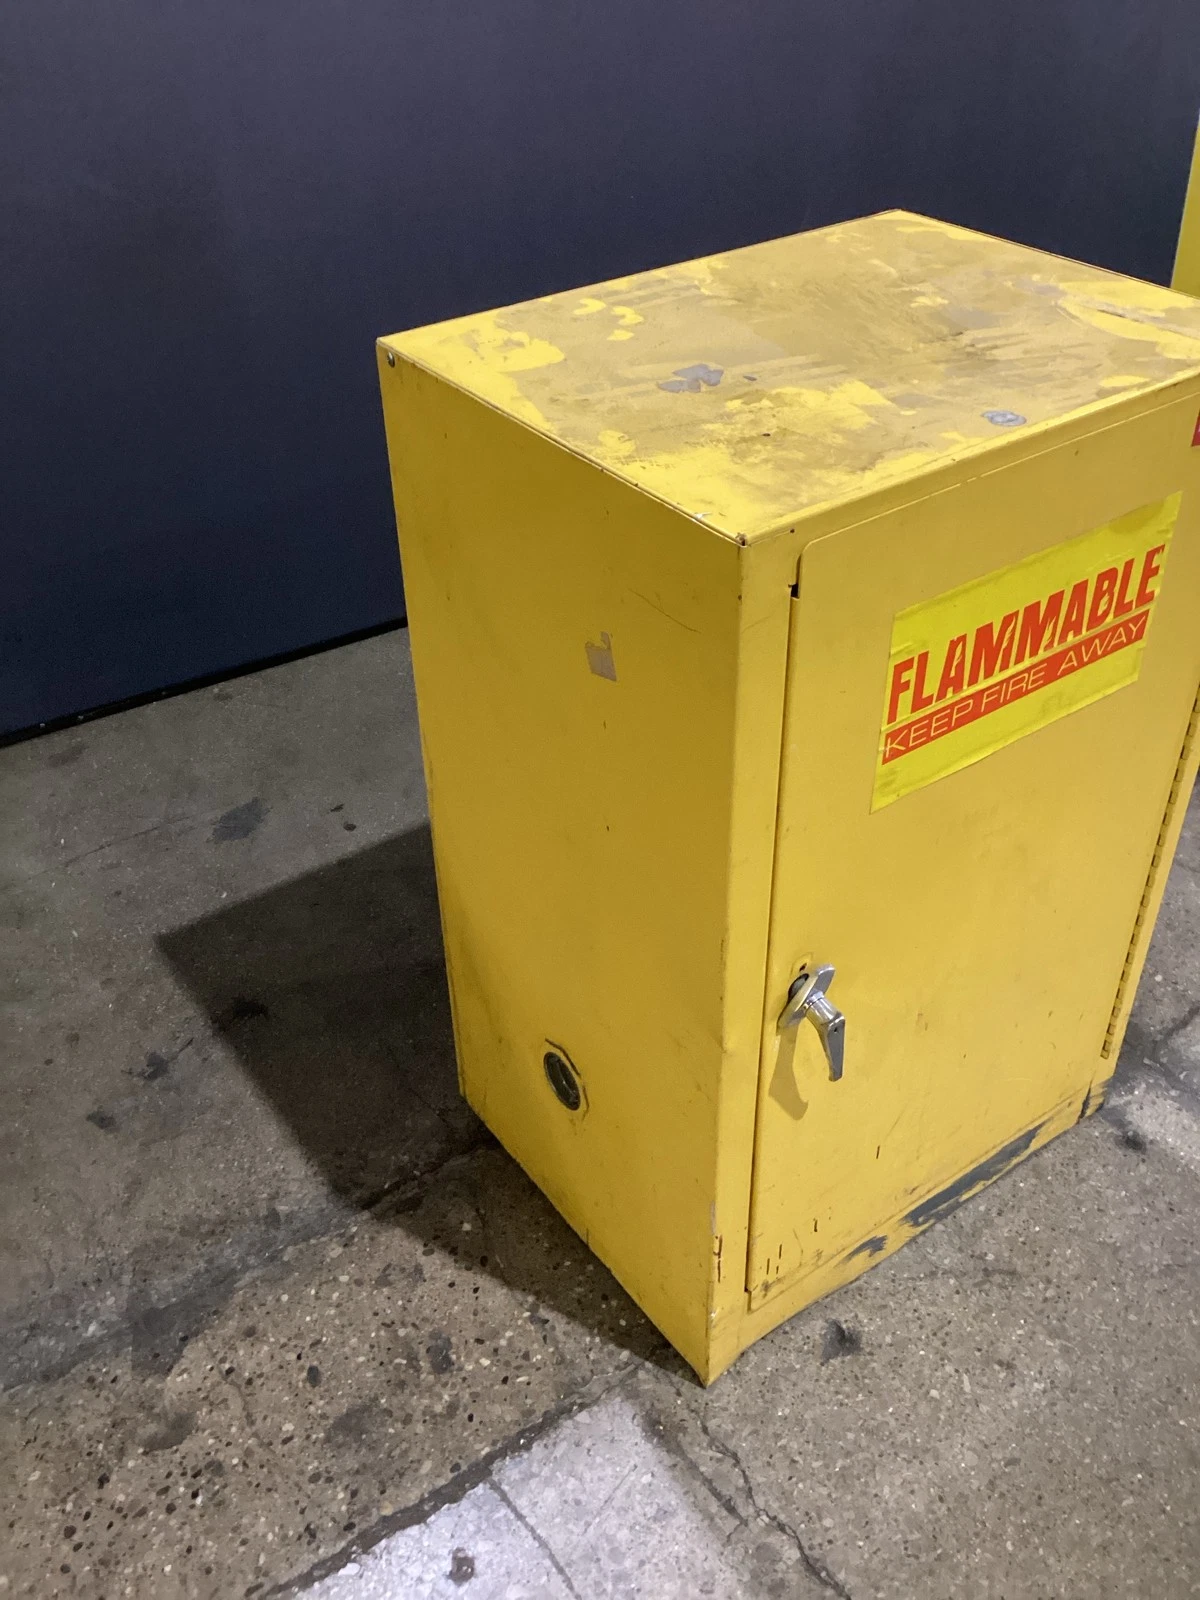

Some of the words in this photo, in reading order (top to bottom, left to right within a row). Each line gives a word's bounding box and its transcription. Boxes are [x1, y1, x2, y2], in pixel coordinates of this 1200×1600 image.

[885, 700, 973, 758] KEEP
[981, 663, 1047, 712] FIRE
[1057, 615, 1146, 676] AWAY
[887, 544, 1165, 725] FLAMMABLE
